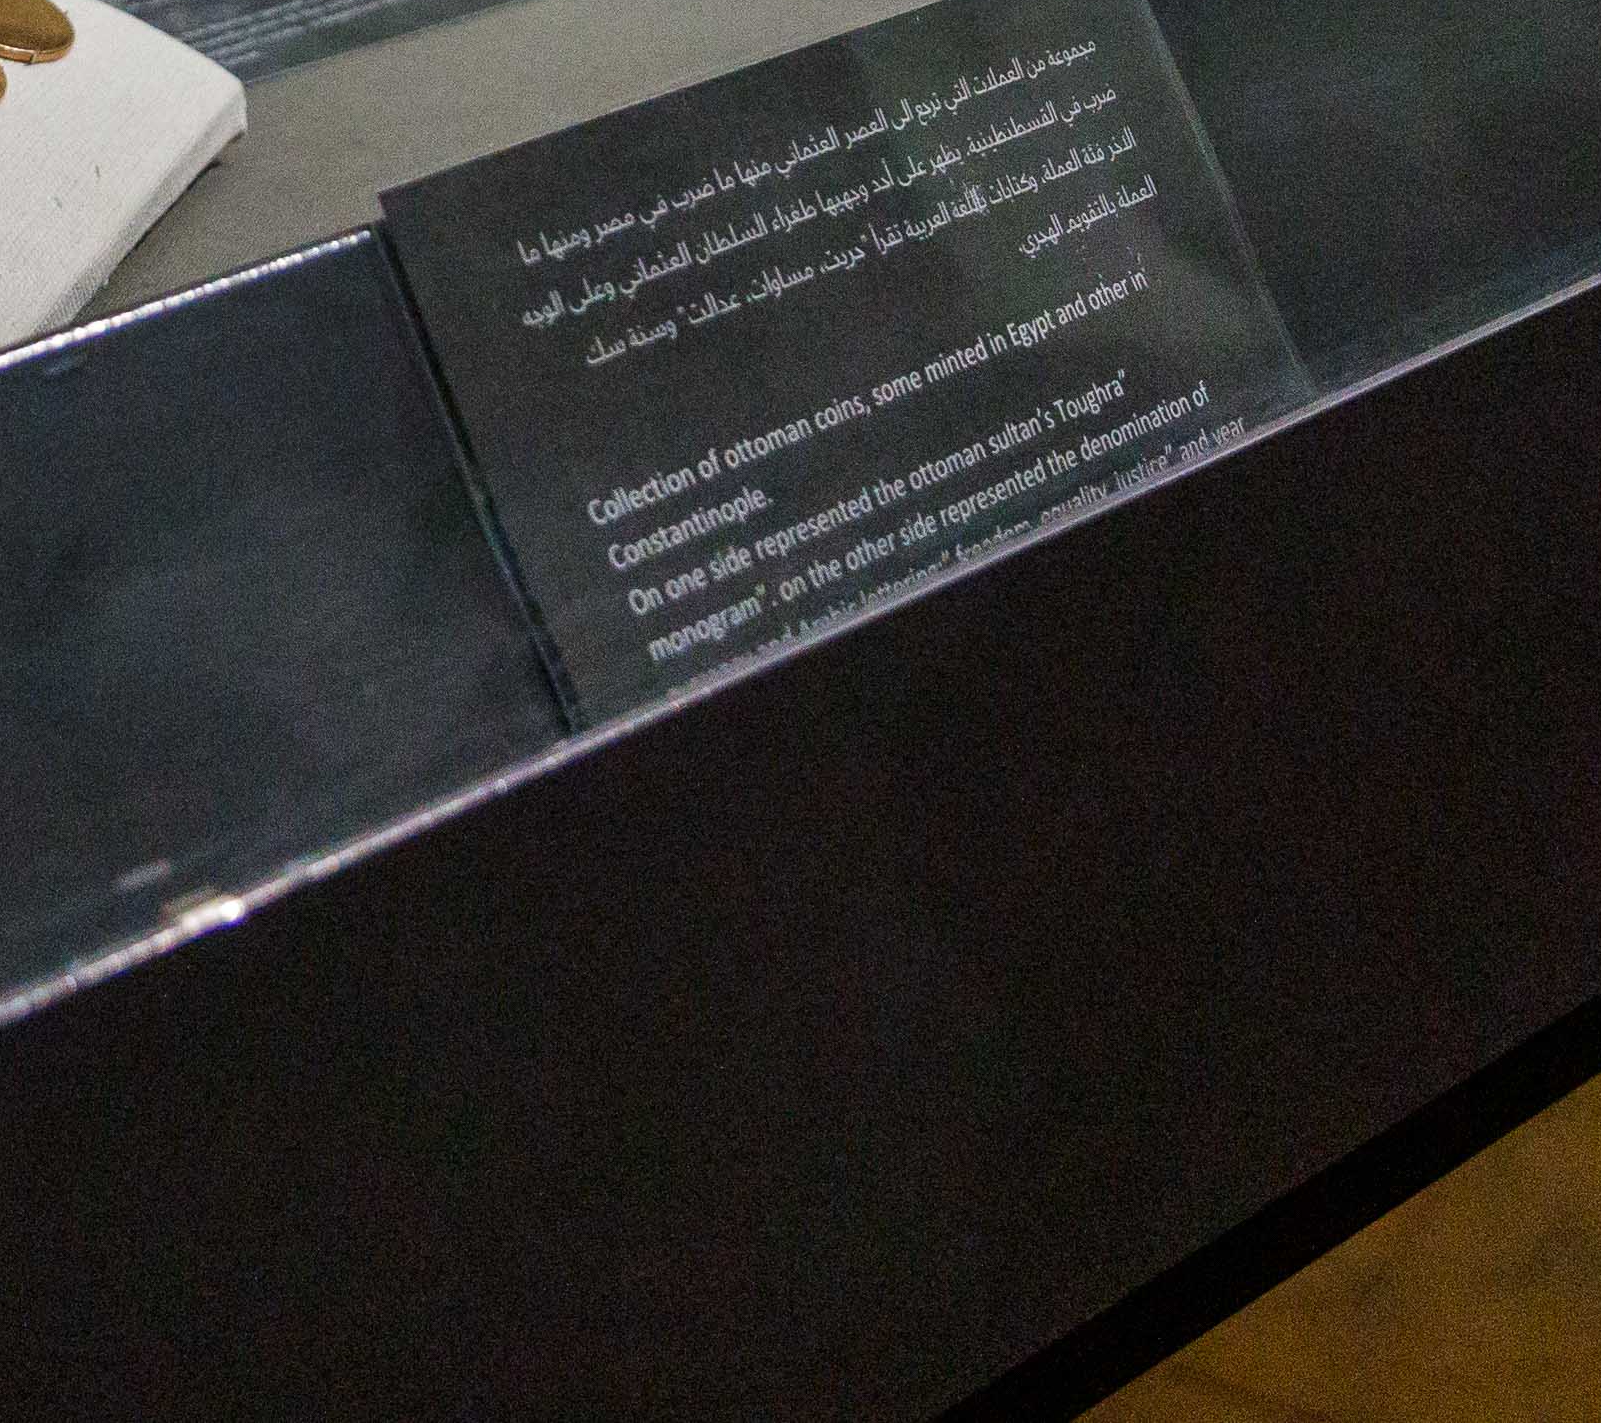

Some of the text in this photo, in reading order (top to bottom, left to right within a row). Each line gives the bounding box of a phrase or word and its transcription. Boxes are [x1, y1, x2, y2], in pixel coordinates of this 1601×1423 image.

[1027, 59, 1046, 80] من
[1045, 40, 1096, 67] مجموعة
[973, 57, 1025, 96] العملات
[914, 92, 942, 126] ترجع
[943, 77, 972, 116] التي
[1083, 88, 1117, 111] ضرب
[844, 108, 889, 150] العصر
[1061, 101, 1082, 128] في
[775, 126, 841, 179] العثماني
[929, 144, 964, 176] يظهر
[1081, 146, 1105, 165] فئة
[713, 168, 736, 191] ما
[733, 161, 772, 187] منها
[871, 160, 895, 193] أحد
[897, 155, 927, 187] على
[671, 183, 716, 209] ضرب
[815, 184, 869, 217] وجهيها
[989, 173, 1039, 205] وكتابات
[1115, 174, 1158, 208] العملة
[595, 212, 635, 244] مصر
[639, 199, 669, 230] في
[903, 200, 952, 241] العربية
[1066, 194, 1117, 234] بالتقويم
[517, 240, 541, 265] ما
[540, 228, 592, 260] ومنها
[695, 212, 769, 265] السلطان
[619, 241, 693, 300] العثماني
[522, 290, 565, 326] الوجه
[569, 278, 616, 315] وعلى
[627, 319, 678, 347] وسنة
[586, 336, 627, 365] سك
[587, 267, 1149, 525] Collection of ottoman coins, some minted in Egypt and other in
[1179, 430, 1210, 466] and
[779, 575, 808, 602] on
[807, 559, 843, 588] the
[845, 532, 895, 571] other
[899, 512, 938, 546] side
[939, 457, 1047, 527] represented
[1046, 449, 1078, 476] the
[1080, 396, 1192, 461] denomination
[1191, 379, 1210, 408] of
[607, 486, 773, 570] Constantinople.
[628, 587, 664, 616] On
[665, 567, 708, 600] one
[708, 546, 752, 581] side
[754, 487, 874, 560] represented
[873, 478, 907, 506] the
[908, 442, 987, 491] ottoman
